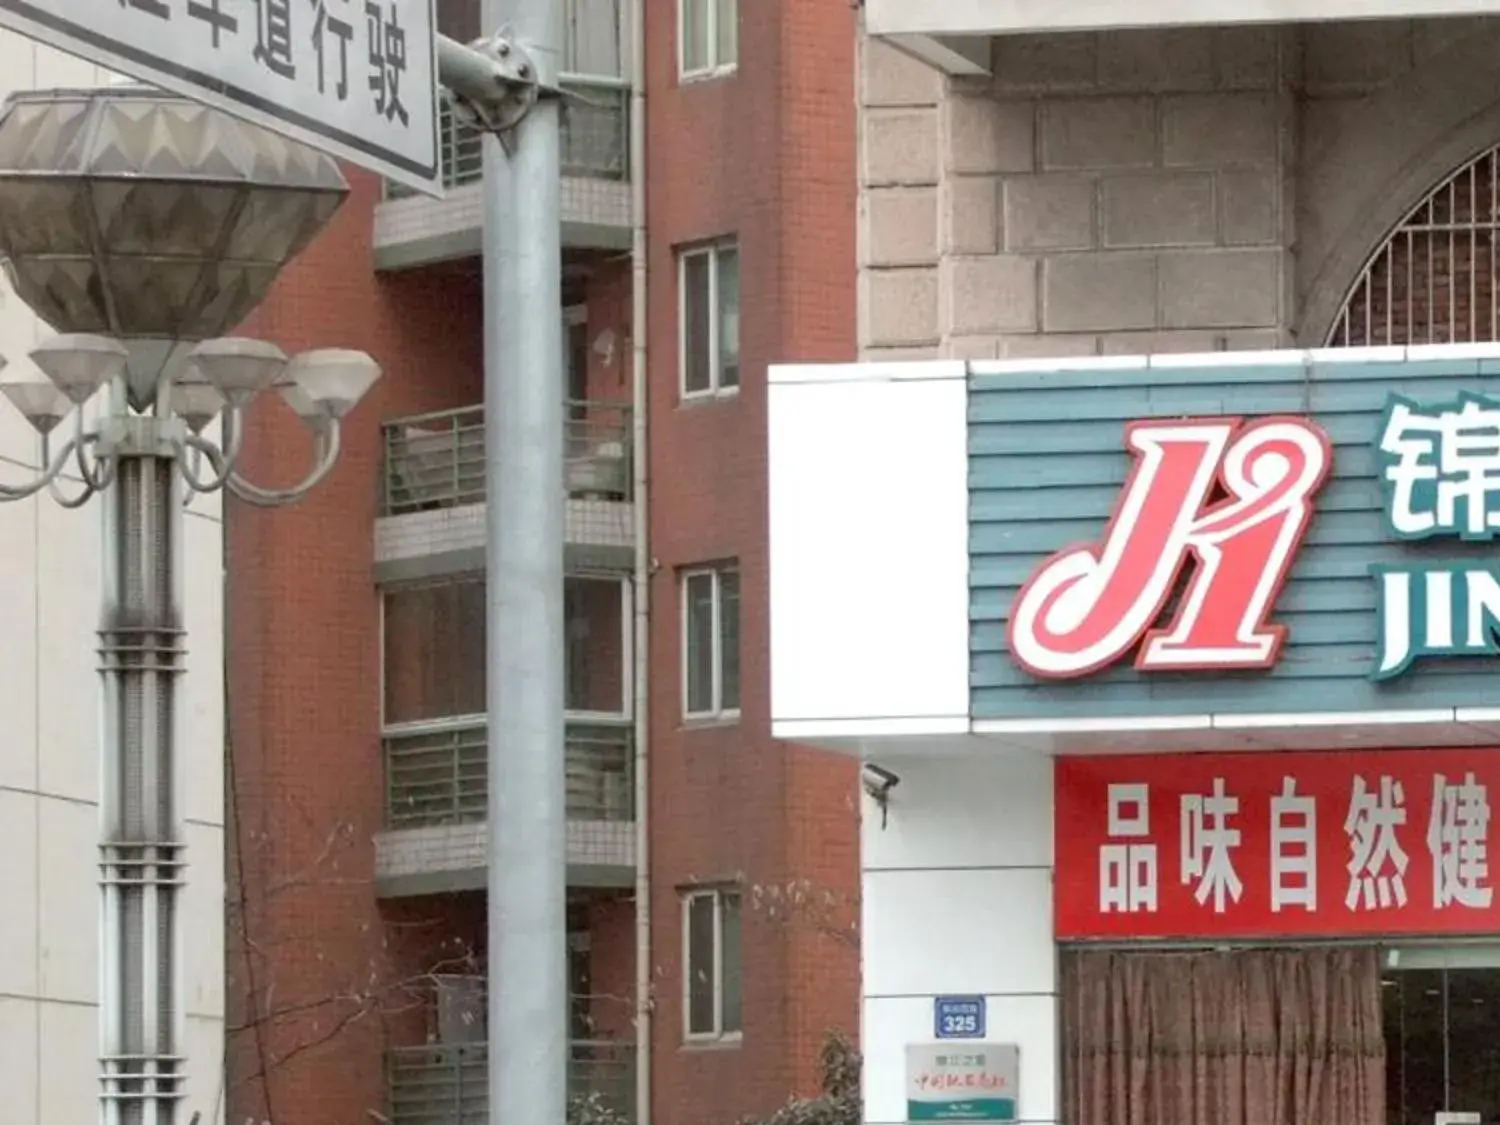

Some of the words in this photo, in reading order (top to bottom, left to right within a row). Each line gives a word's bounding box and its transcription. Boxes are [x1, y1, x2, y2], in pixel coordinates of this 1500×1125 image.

[117, 0, 410, 128] 道行驶
[944, 1015, 976, 1032] 325
